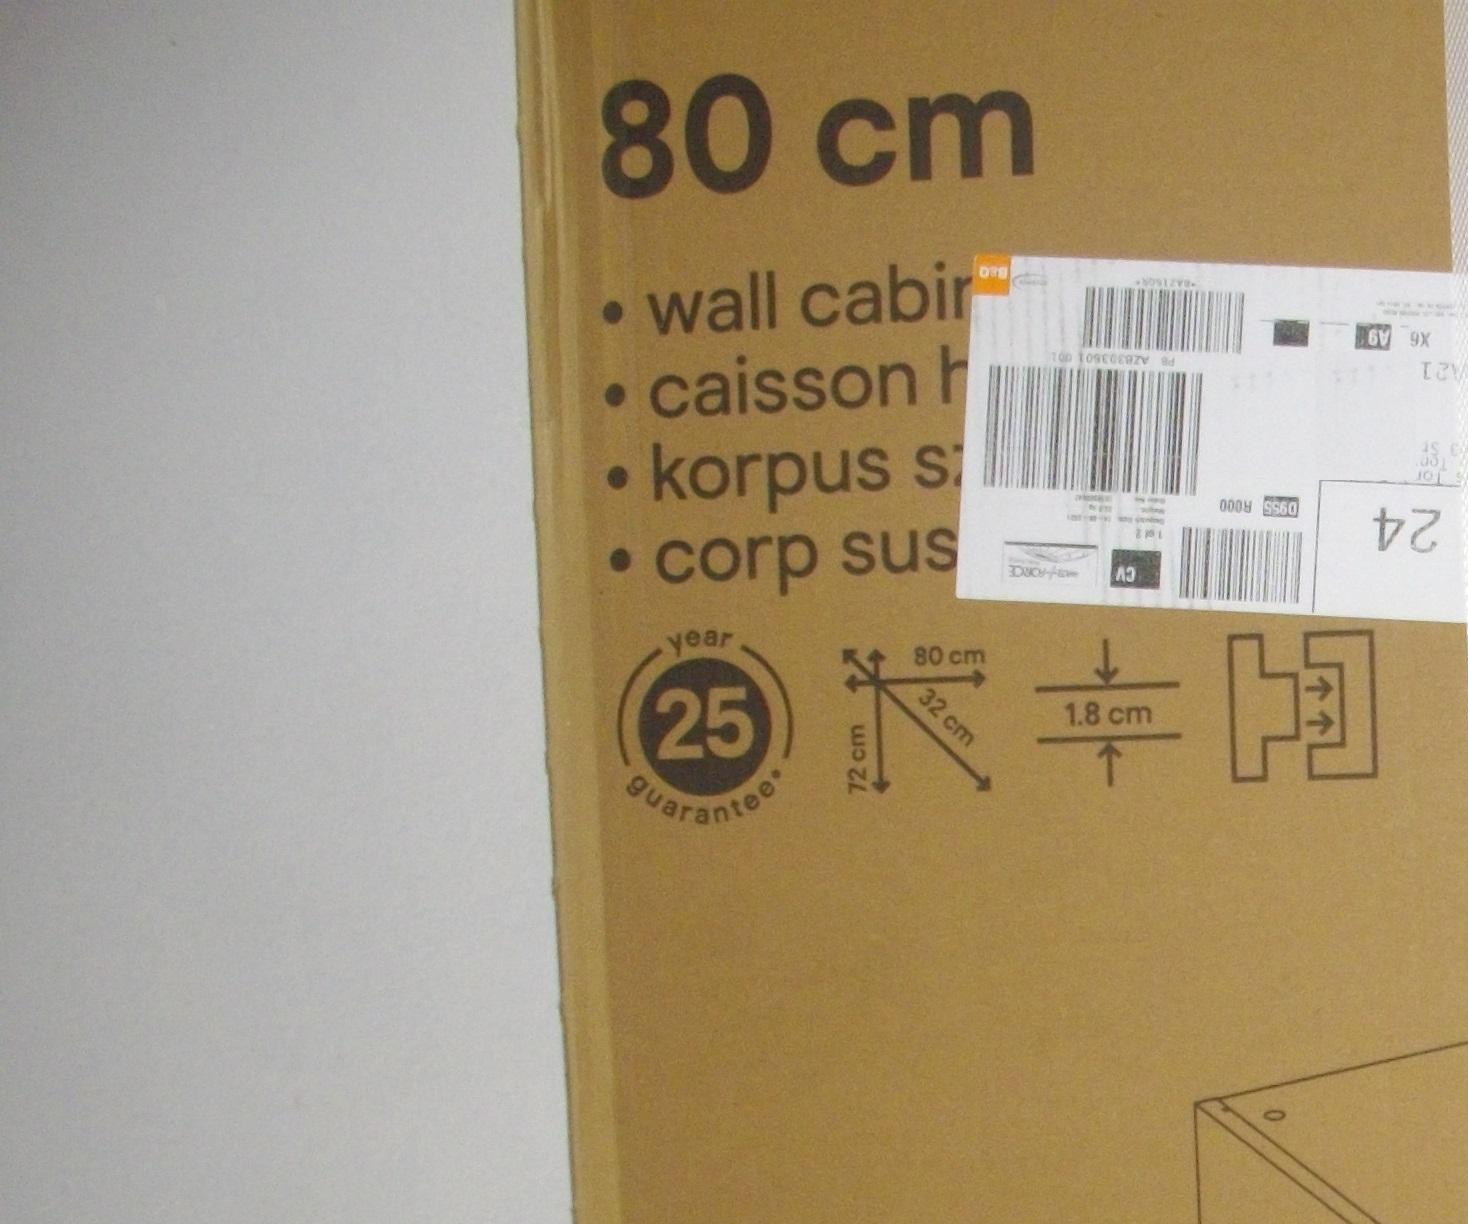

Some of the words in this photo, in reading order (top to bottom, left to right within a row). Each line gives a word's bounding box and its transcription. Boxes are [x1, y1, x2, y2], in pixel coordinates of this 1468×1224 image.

[601, 73, 773, 200] 80
[816, 90, 1034, 187] cm
[647, 271, 777, 336] wall
[649, 355, 917, 420] caisson
[652, 442, 891, 514] korpus
[1373, 507, 1441, 553] 24
[655, 534, 818, 597] corp
[1115, 566, 1136, 583] CV
[667, 629, 734, 658] year
[914, 645, 943, 667] 80
[949, 649, 986, 665] cm
[656, 686, 755, 761] 25
[918, 688, 947, 718] 32
[943, 715, 975, 747] cm
[1065, 701, 1101, 727] 1.8
[1107, 704, 1153, 726] cm
[851, 724, 867, 762] cm
[626, 775, 775, 825] guarantee
[846, 766, 869, 795] 72
